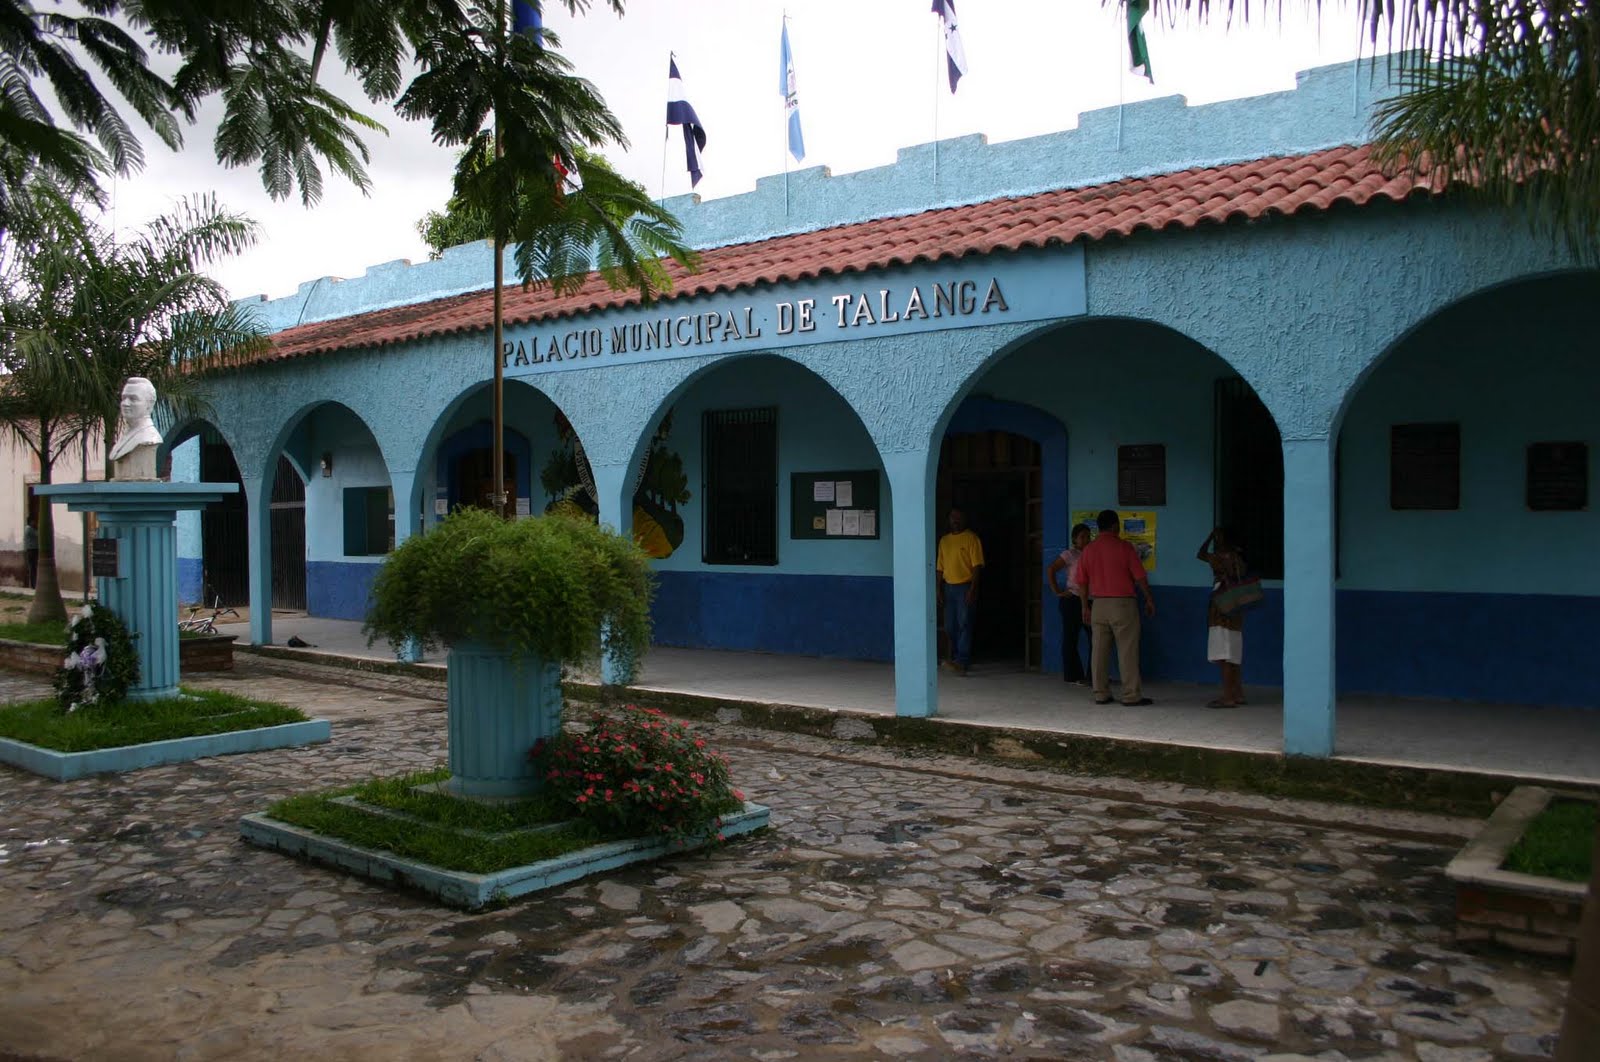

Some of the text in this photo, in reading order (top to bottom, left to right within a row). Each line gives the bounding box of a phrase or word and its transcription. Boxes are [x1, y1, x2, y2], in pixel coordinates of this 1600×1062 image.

[503, 277, 1009, 368] PALACIO MUNICIPAL DE TALANGA
